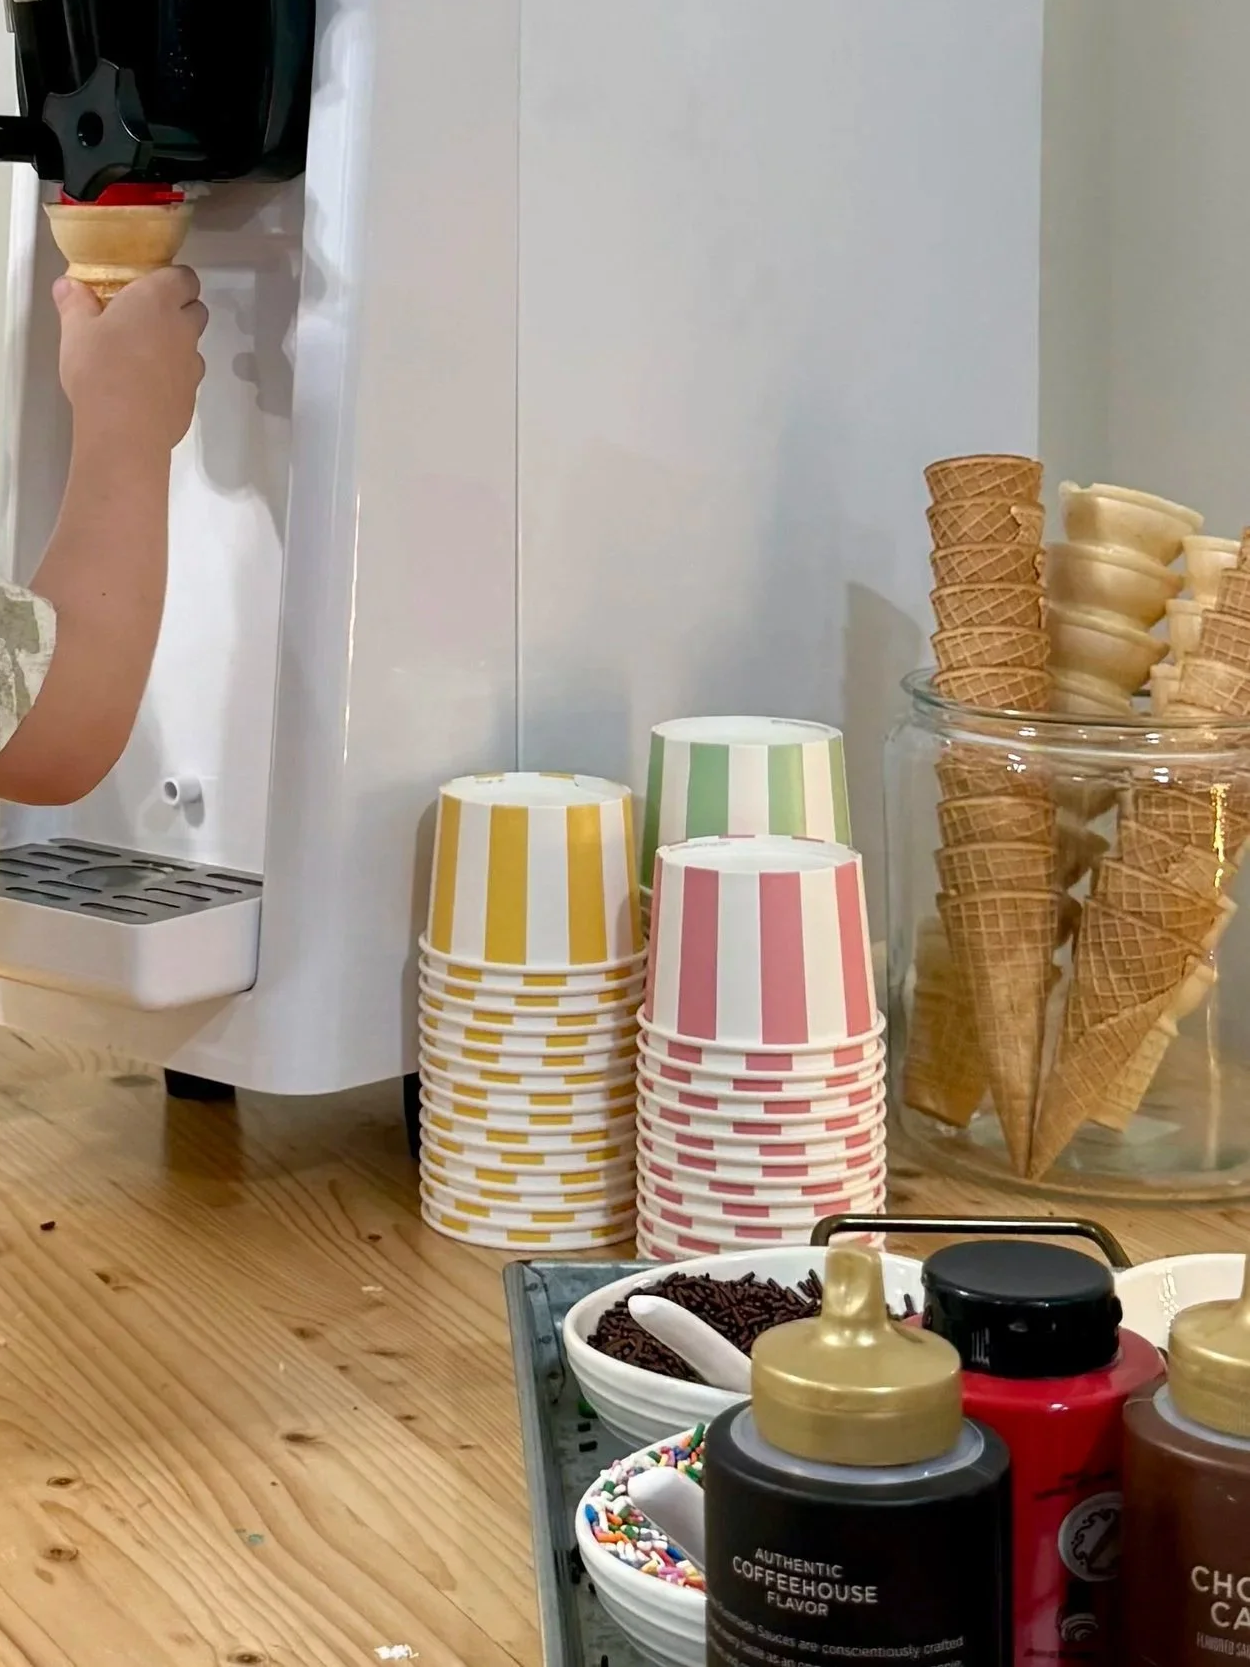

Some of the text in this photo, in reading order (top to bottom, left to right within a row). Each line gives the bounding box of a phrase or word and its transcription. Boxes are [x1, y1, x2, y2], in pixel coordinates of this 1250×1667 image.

[754, 1547, 843, 1578] AUTHENTIC
[732, 1555, 879, 1604] COFFEEHOUSE
[766, 1590, 830, 1617] FLAVOR
[757, 1624, 796, 1648] Sauces
[822, 1642, 920, 1660] conscientiously
[924, 1636, 965, 1654] crafted
